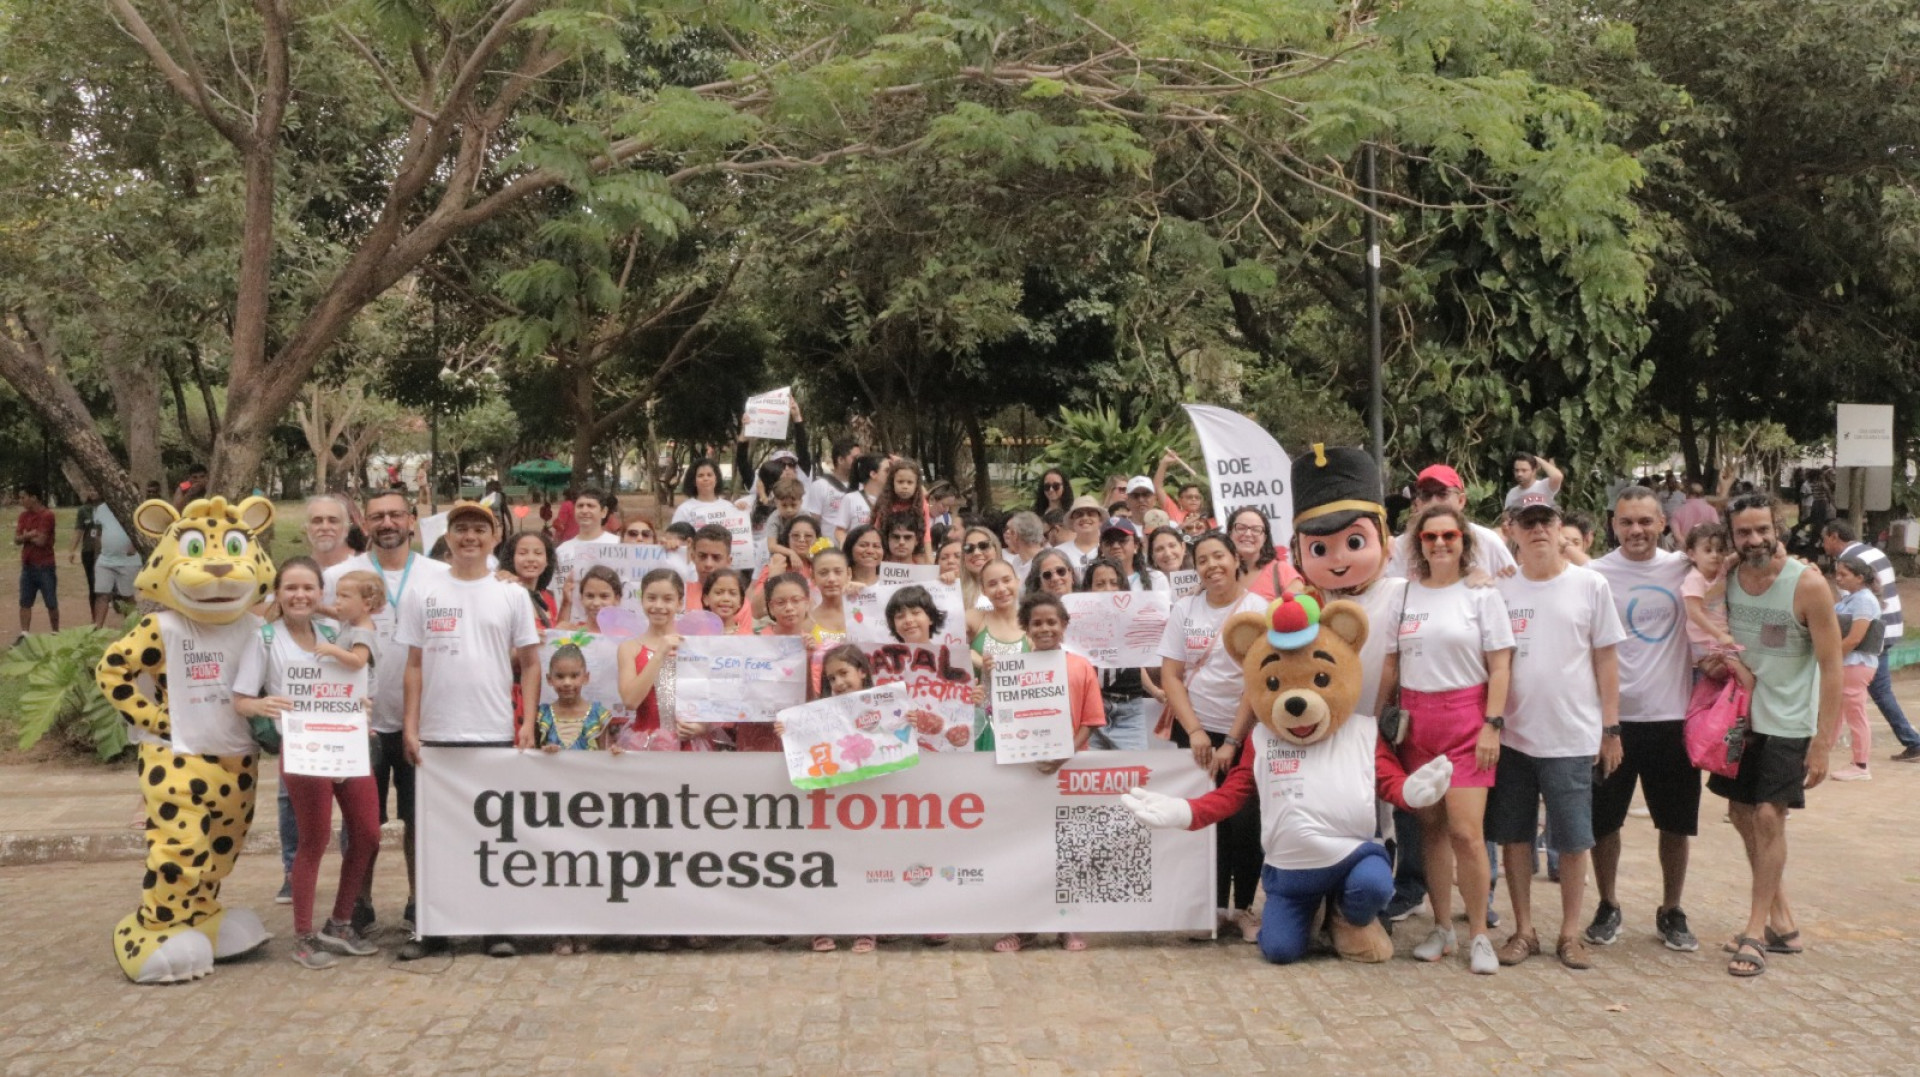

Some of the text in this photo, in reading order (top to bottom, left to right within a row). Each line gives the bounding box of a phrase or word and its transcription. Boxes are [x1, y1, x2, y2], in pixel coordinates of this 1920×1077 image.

[1217, 457, 1252, 476] DOE
[1220, 479, 1284, 499] PARA O
[1224, 503, 1280, 521] NAL
[884, 566, 910, 578] QUEM
[1174, 574, 1199, 585] QUEM
[426, 597, 437, 608] EU
[426, 608, 464, 619] COMBATO
[183, 638, 194, 651] EU
[184, 652, 224, 664] COMBATO
[712, 656, 741, 671] SEM
[868, 644, 971, 684] ATAL
[192, 664, 218, 679] FOME
[995, 660, 1025, 672] QUEM
[288, 666, 322, 680] QUEM
[996, 671, 1050, 687] TEM FOME
[287, 684, 350, 698] TEM FOME
[996, 685, 1065, 702] TEM PRESSA!
[294, 700, 363, 713] EM PRESSA!
[1266, 739, 1279, 748] EU
[1266, 749, 1307, 760] COMBATO
[1070, 771, 1139, 792] DOE AQUI
[957, 868, 985, 877] inec
